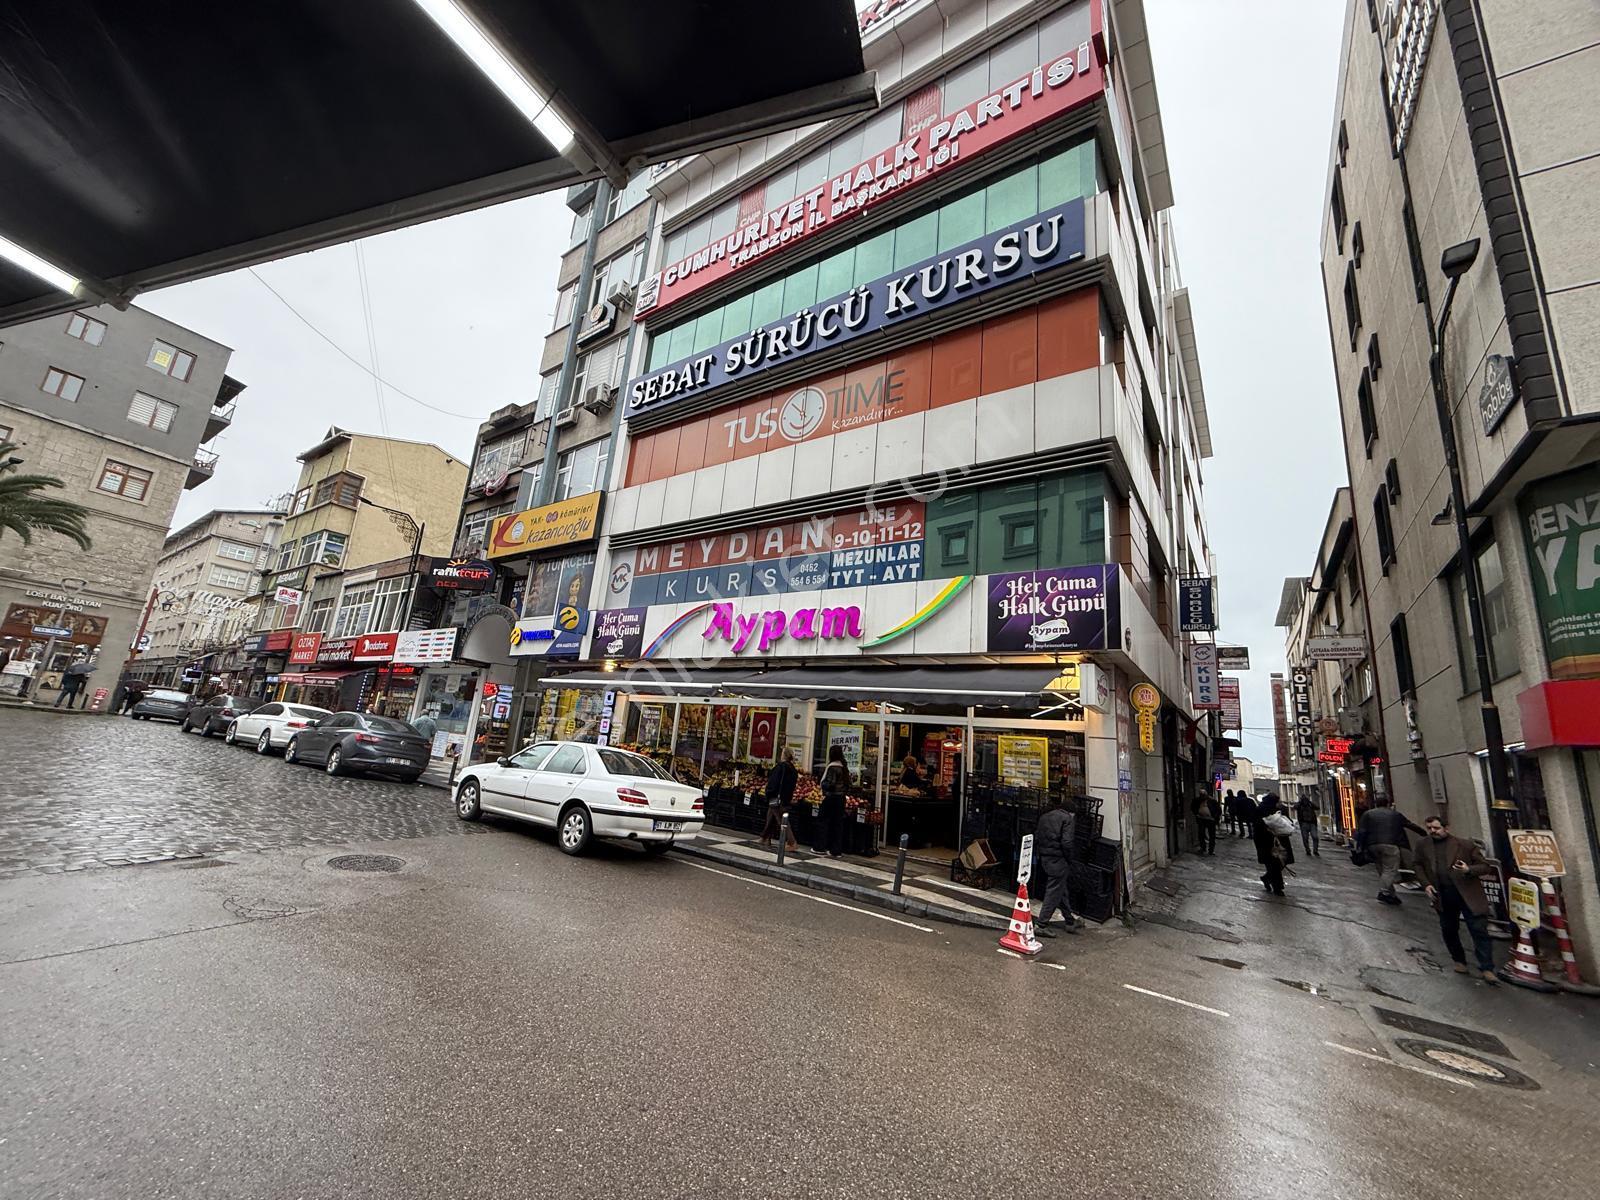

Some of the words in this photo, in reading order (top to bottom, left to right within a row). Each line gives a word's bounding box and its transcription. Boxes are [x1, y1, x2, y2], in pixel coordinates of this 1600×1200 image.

[663, 187, 824, 286] CUMHURİYET
[831, 135, 921, 199] HALK
[929, 41, 1090, 151] PARTİSİ
[729, 221, 803, 268] TRABZON
[808, 211, 826, 229] İL
[831, 141, 959, 219] BAŞKANLIĞI
[629, 354, 714, 408] SEBAT
[725, 285, 871, 373] SÜRÜCÜ
[885, 213, 1063, 316] KURSU
[827, 369, 906, 418] TIME
[724, 407, 778, 448] TUS
[526, 516, 591, 544] kazancıoğlu
[834, 522, 922, 548] 9-10-11-12
[639, 520, 826, 572] MEYDAN
[832, 544, 921, 568] MEZUNLAR
[666, 568, 777, 597] KURS
[831, 569, 865, 586] TYT
[882, 563, 920, 582] AYT
[1006, 576, 1041, 598] Her
[1046, 577, 1097, 593] Cuma
[1181, 579, 1209, 587] SEBAT
[998, 595, 1051, 619] Halk
[1052, 594, 1105, 617] Günü
[702, 602, 863, 653] Aypam
[1197, 666, 1212, 703] KURS
[845, 736, 859, 744] AYIN
[1298, 716, 1313, 757] GOLD
[1515, 836, 1552, 845] CAM
[1520, 845, 1553, 853] AYNA
